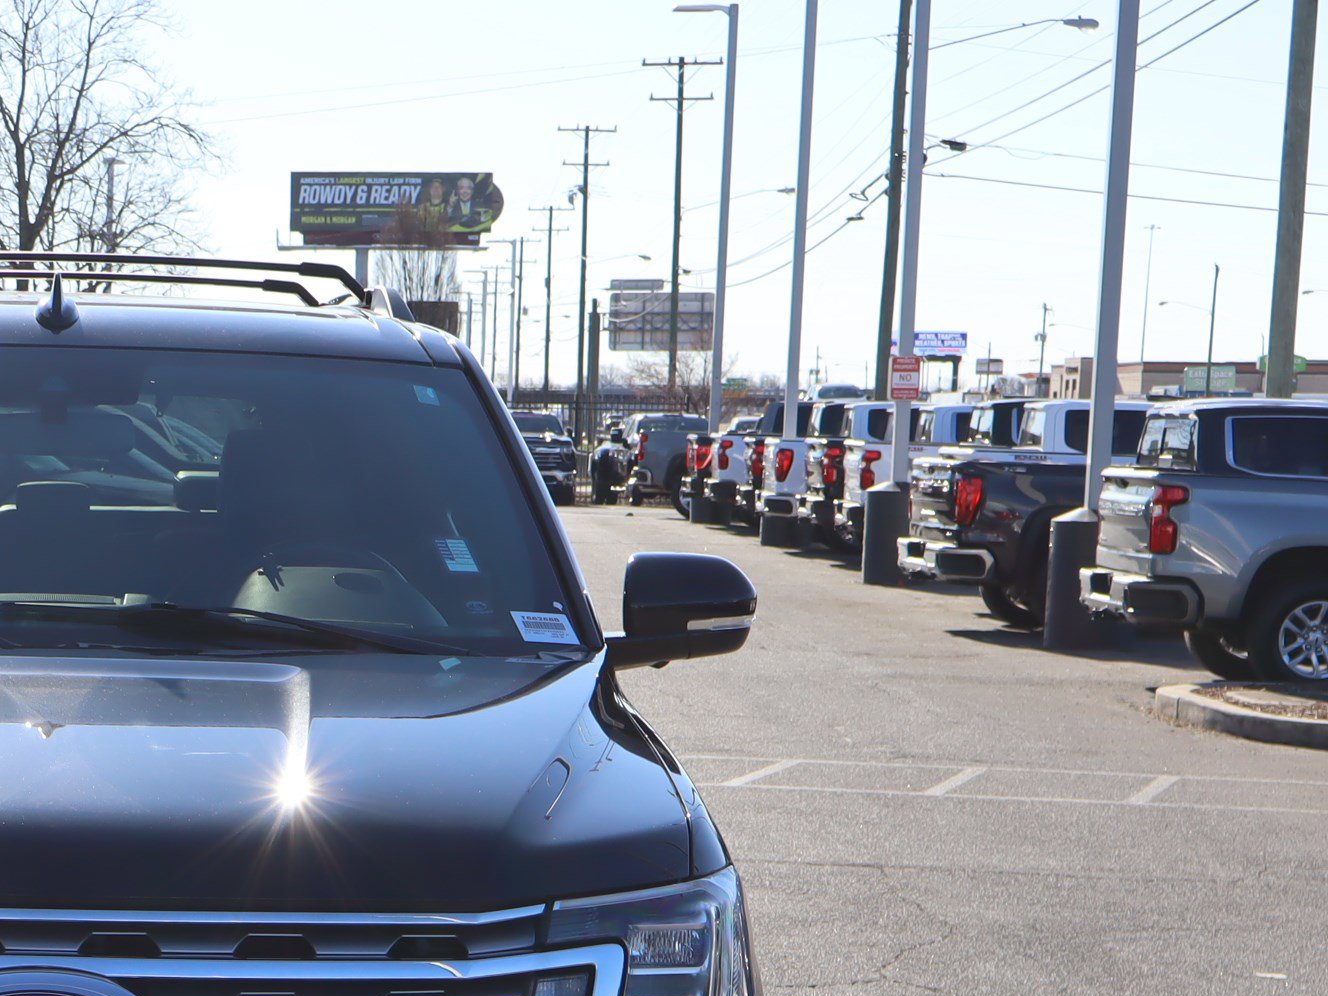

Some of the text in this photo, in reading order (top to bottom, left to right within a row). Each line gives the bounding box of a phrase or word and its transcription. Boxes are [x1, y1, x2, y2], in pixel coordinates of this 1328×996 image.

[298, 185, 422, 205] ROWDY & READY
[301, 216, 325, 224] MORGAN
[332, 216, 356, 224] MORGAN
[899, 373, 912, 382] NO
